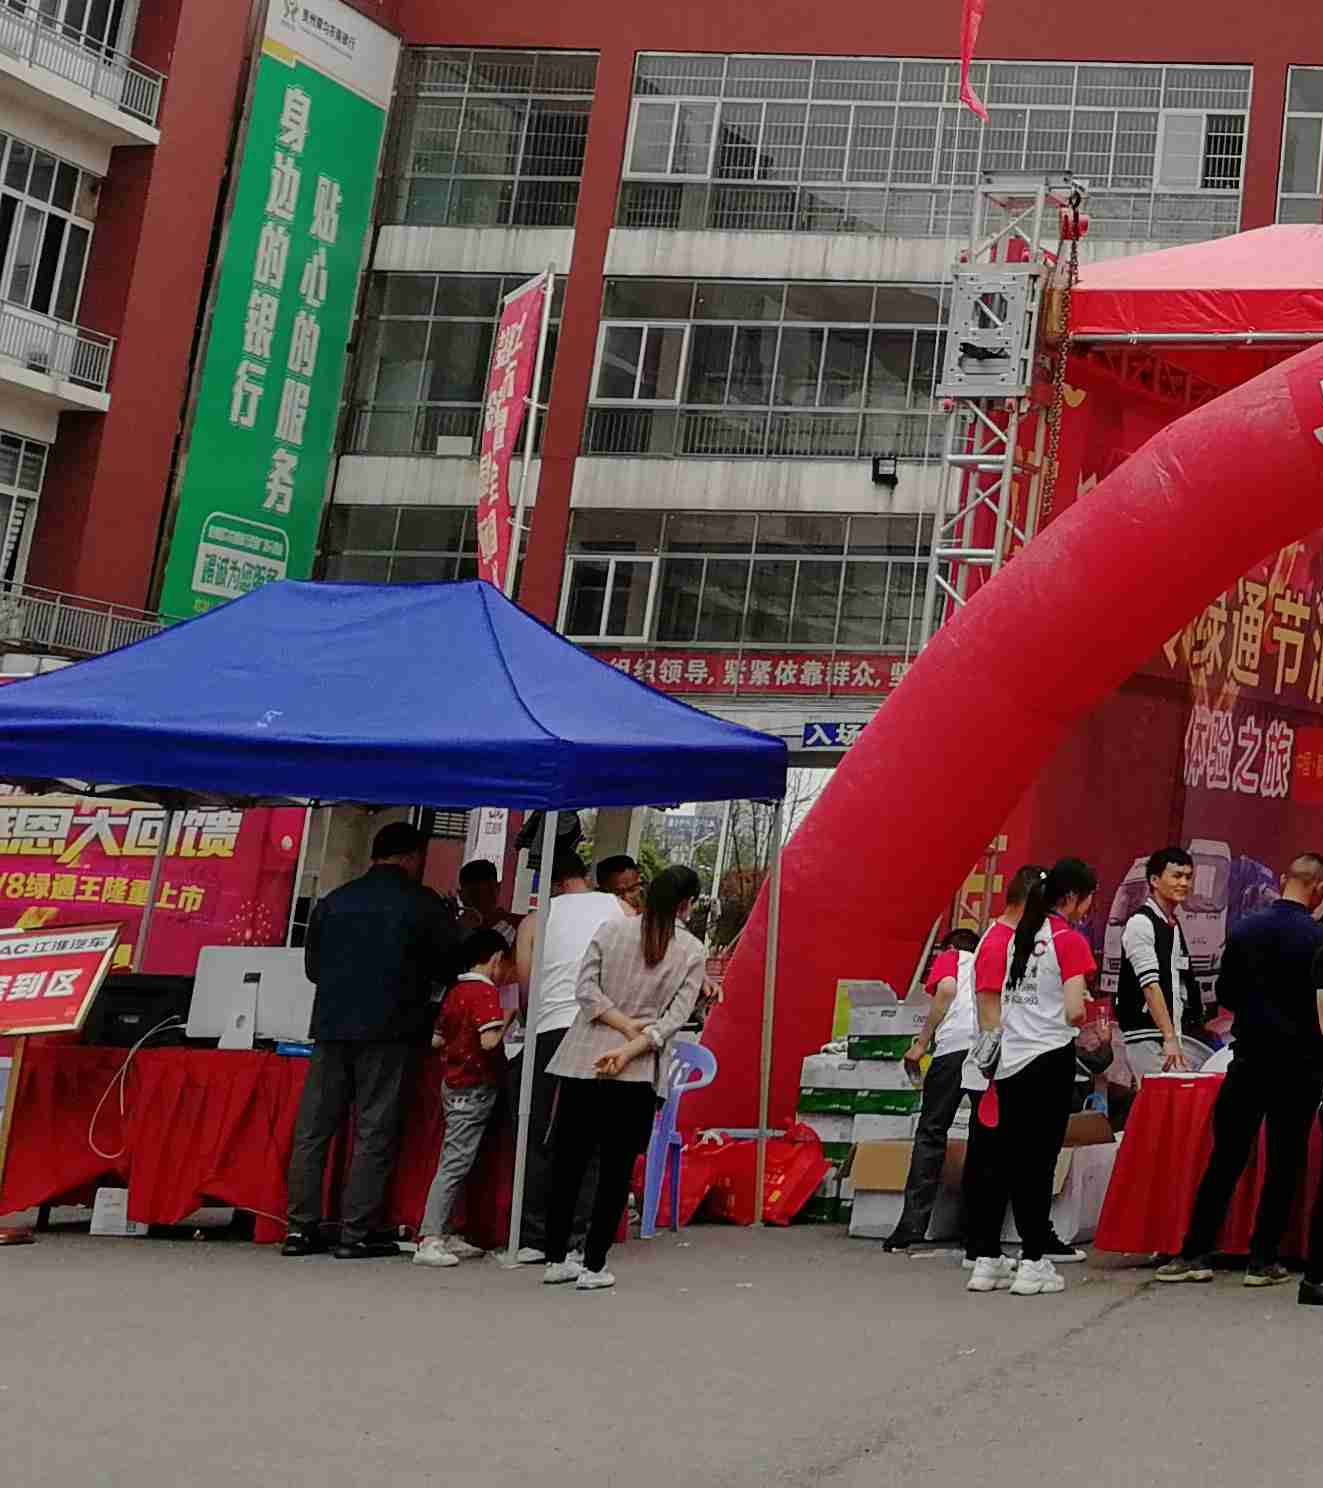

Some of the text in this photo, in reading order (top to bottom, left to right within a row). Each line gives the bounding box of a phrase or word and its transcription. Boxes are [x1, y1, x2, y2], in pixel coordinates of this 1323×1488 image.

[229, 85, 311, 429] 身边的银行
[264, 175, 343, 513] 贴心的服务
